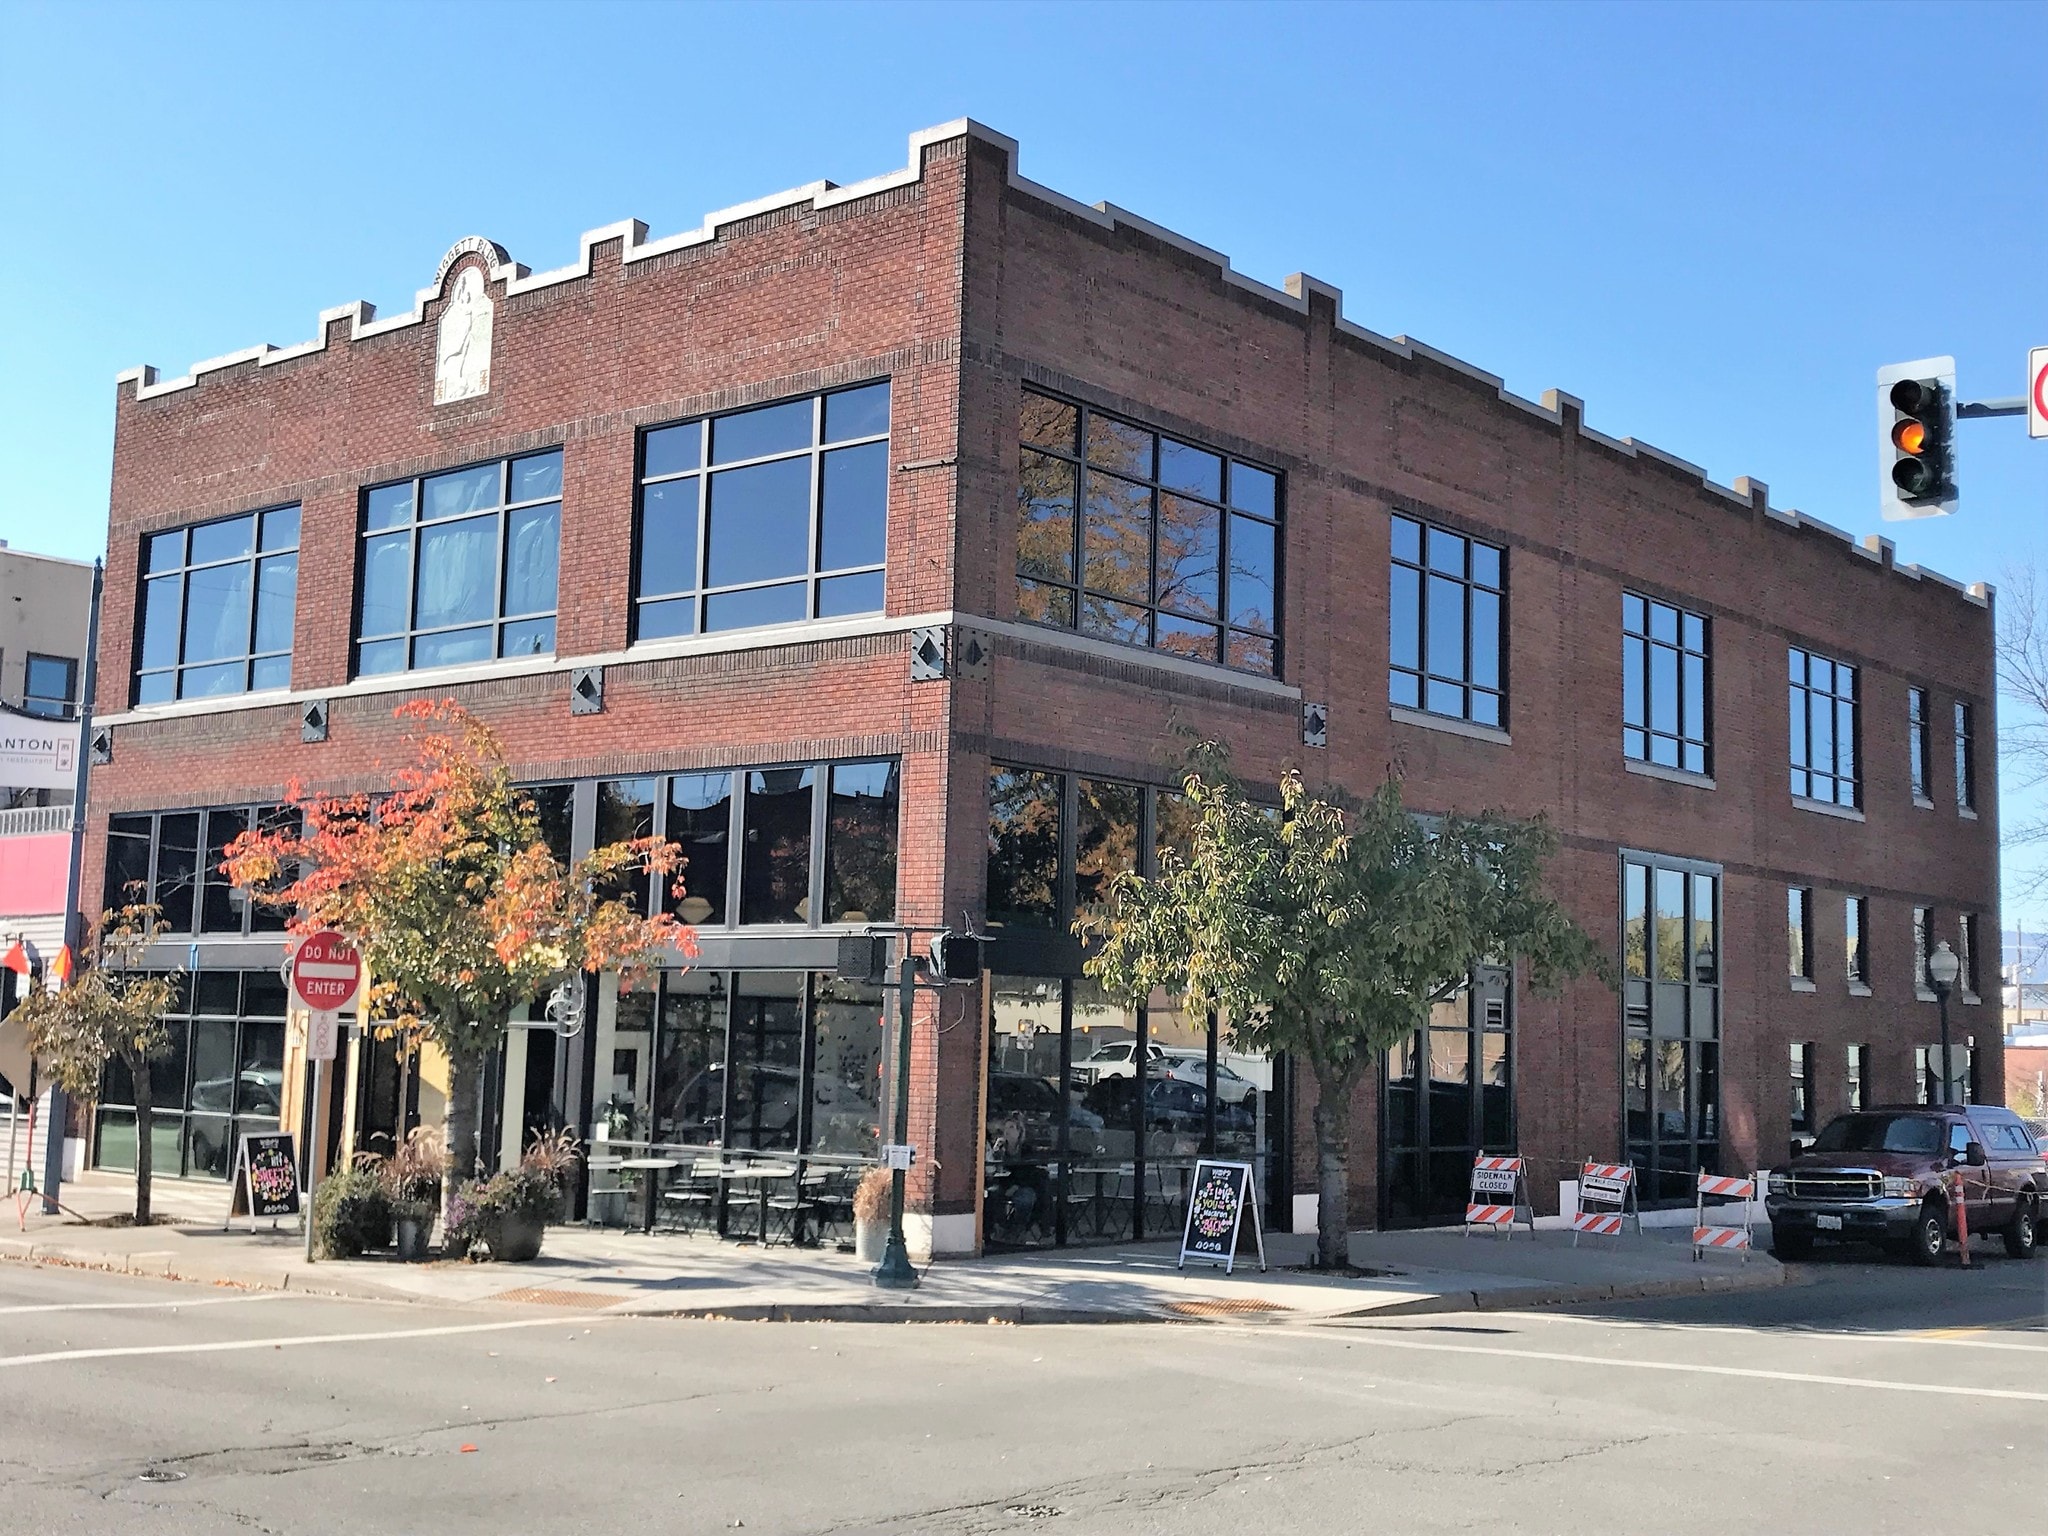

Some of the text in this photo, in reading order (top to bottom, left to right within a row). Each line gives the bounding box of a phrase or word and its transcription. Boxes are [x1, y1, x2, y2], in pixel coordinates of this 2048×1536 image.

[477, 239, 498, 269] BLDG
[0, 738, 53, 750] NTON
[305, 945, 353, 961] DO NOT
[306, 980, 346, 996] ENTER
[1477, 1171, 1513, 1180] SIDEWALK
[1479, 1181, 1508, 1190] CLOSED
[1201, 1199, 1218, 1210] YOU
